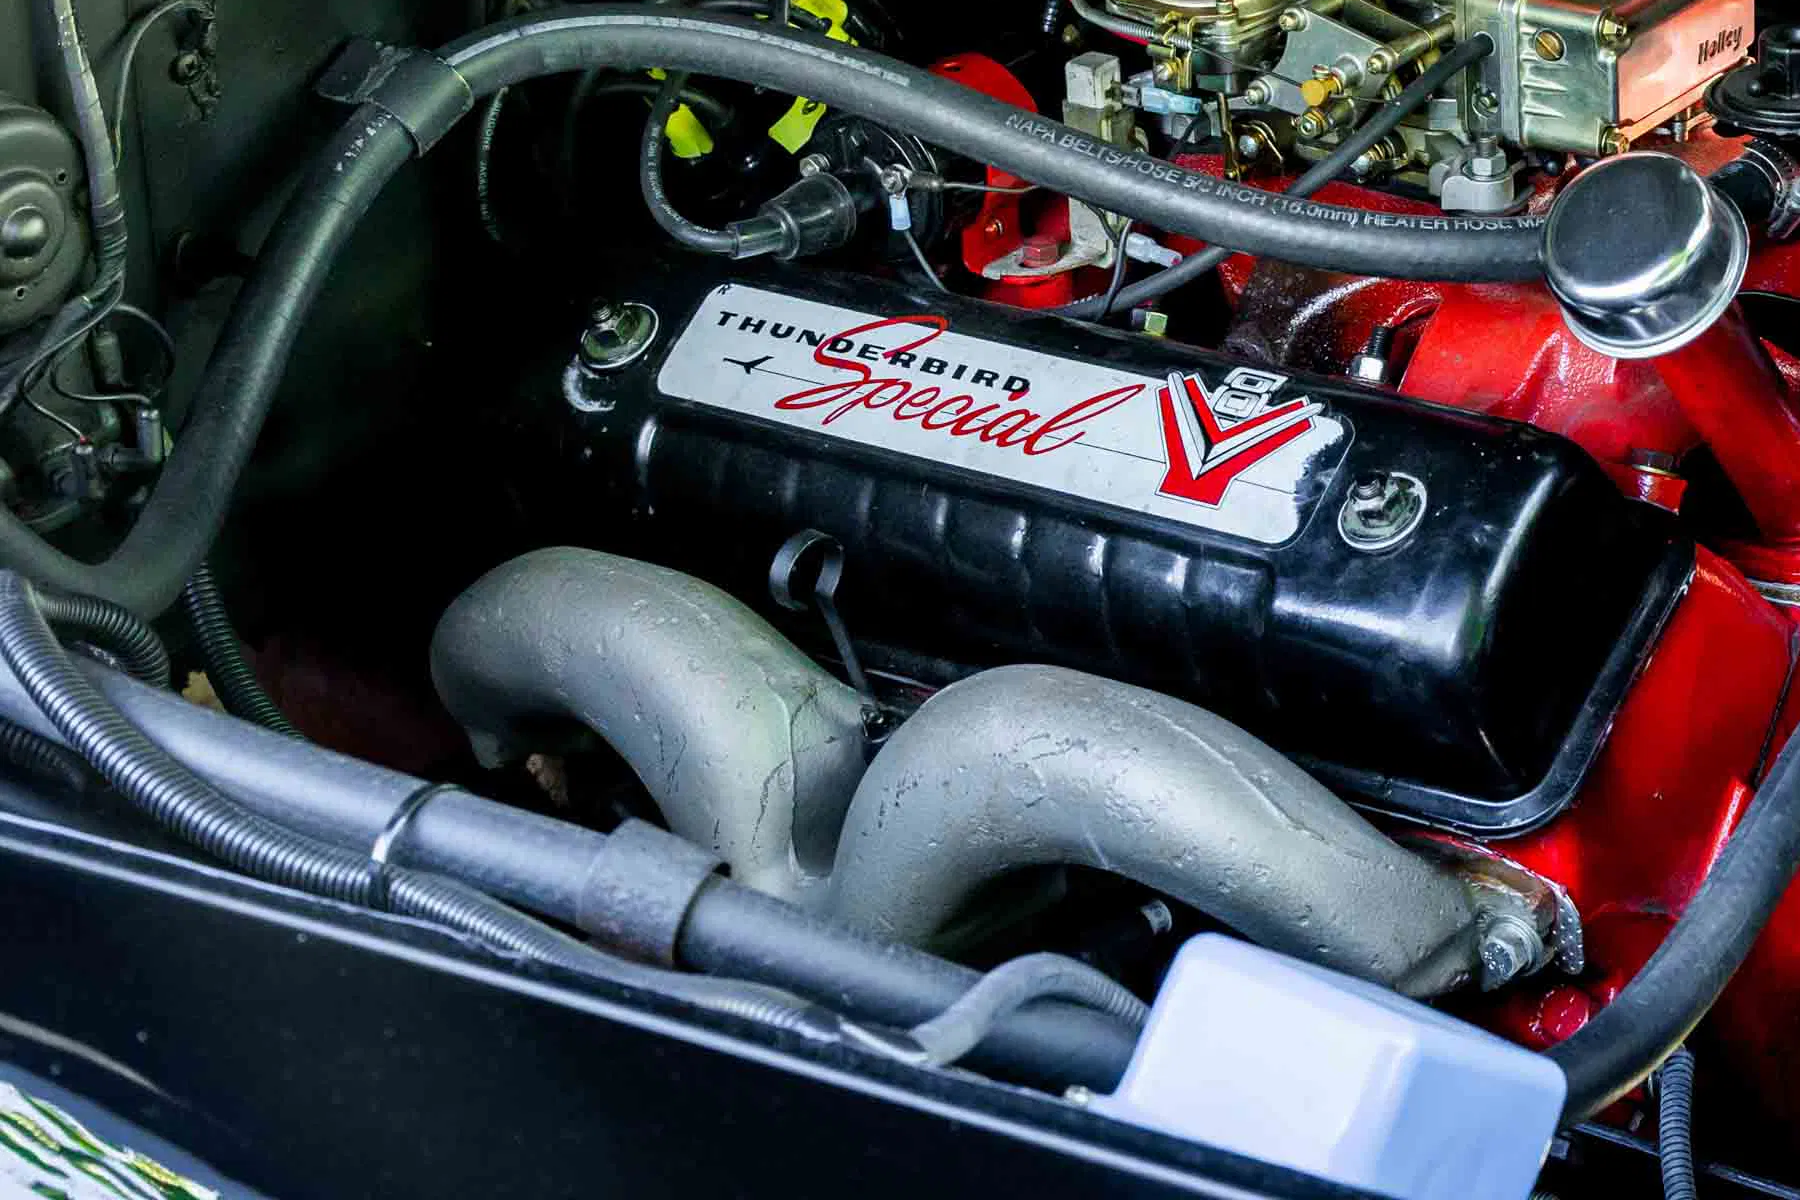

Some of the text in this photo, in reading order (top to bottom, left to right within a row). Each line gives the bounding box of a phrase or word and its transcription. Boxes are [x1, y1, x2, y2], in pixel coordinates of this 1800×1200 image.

[1698, 25, 1743, 65] Holley
[1004, 111, 1056, 144] NAPA
[1215, 181, 1266, 208] INCH
[1363, 211, 1449, 232] HEATER
[1454, 218, 1513, 232] HOSE
[716, 310, 1031, 394] THUNDERBIRD
[774, 314, 1147, 457] Special
